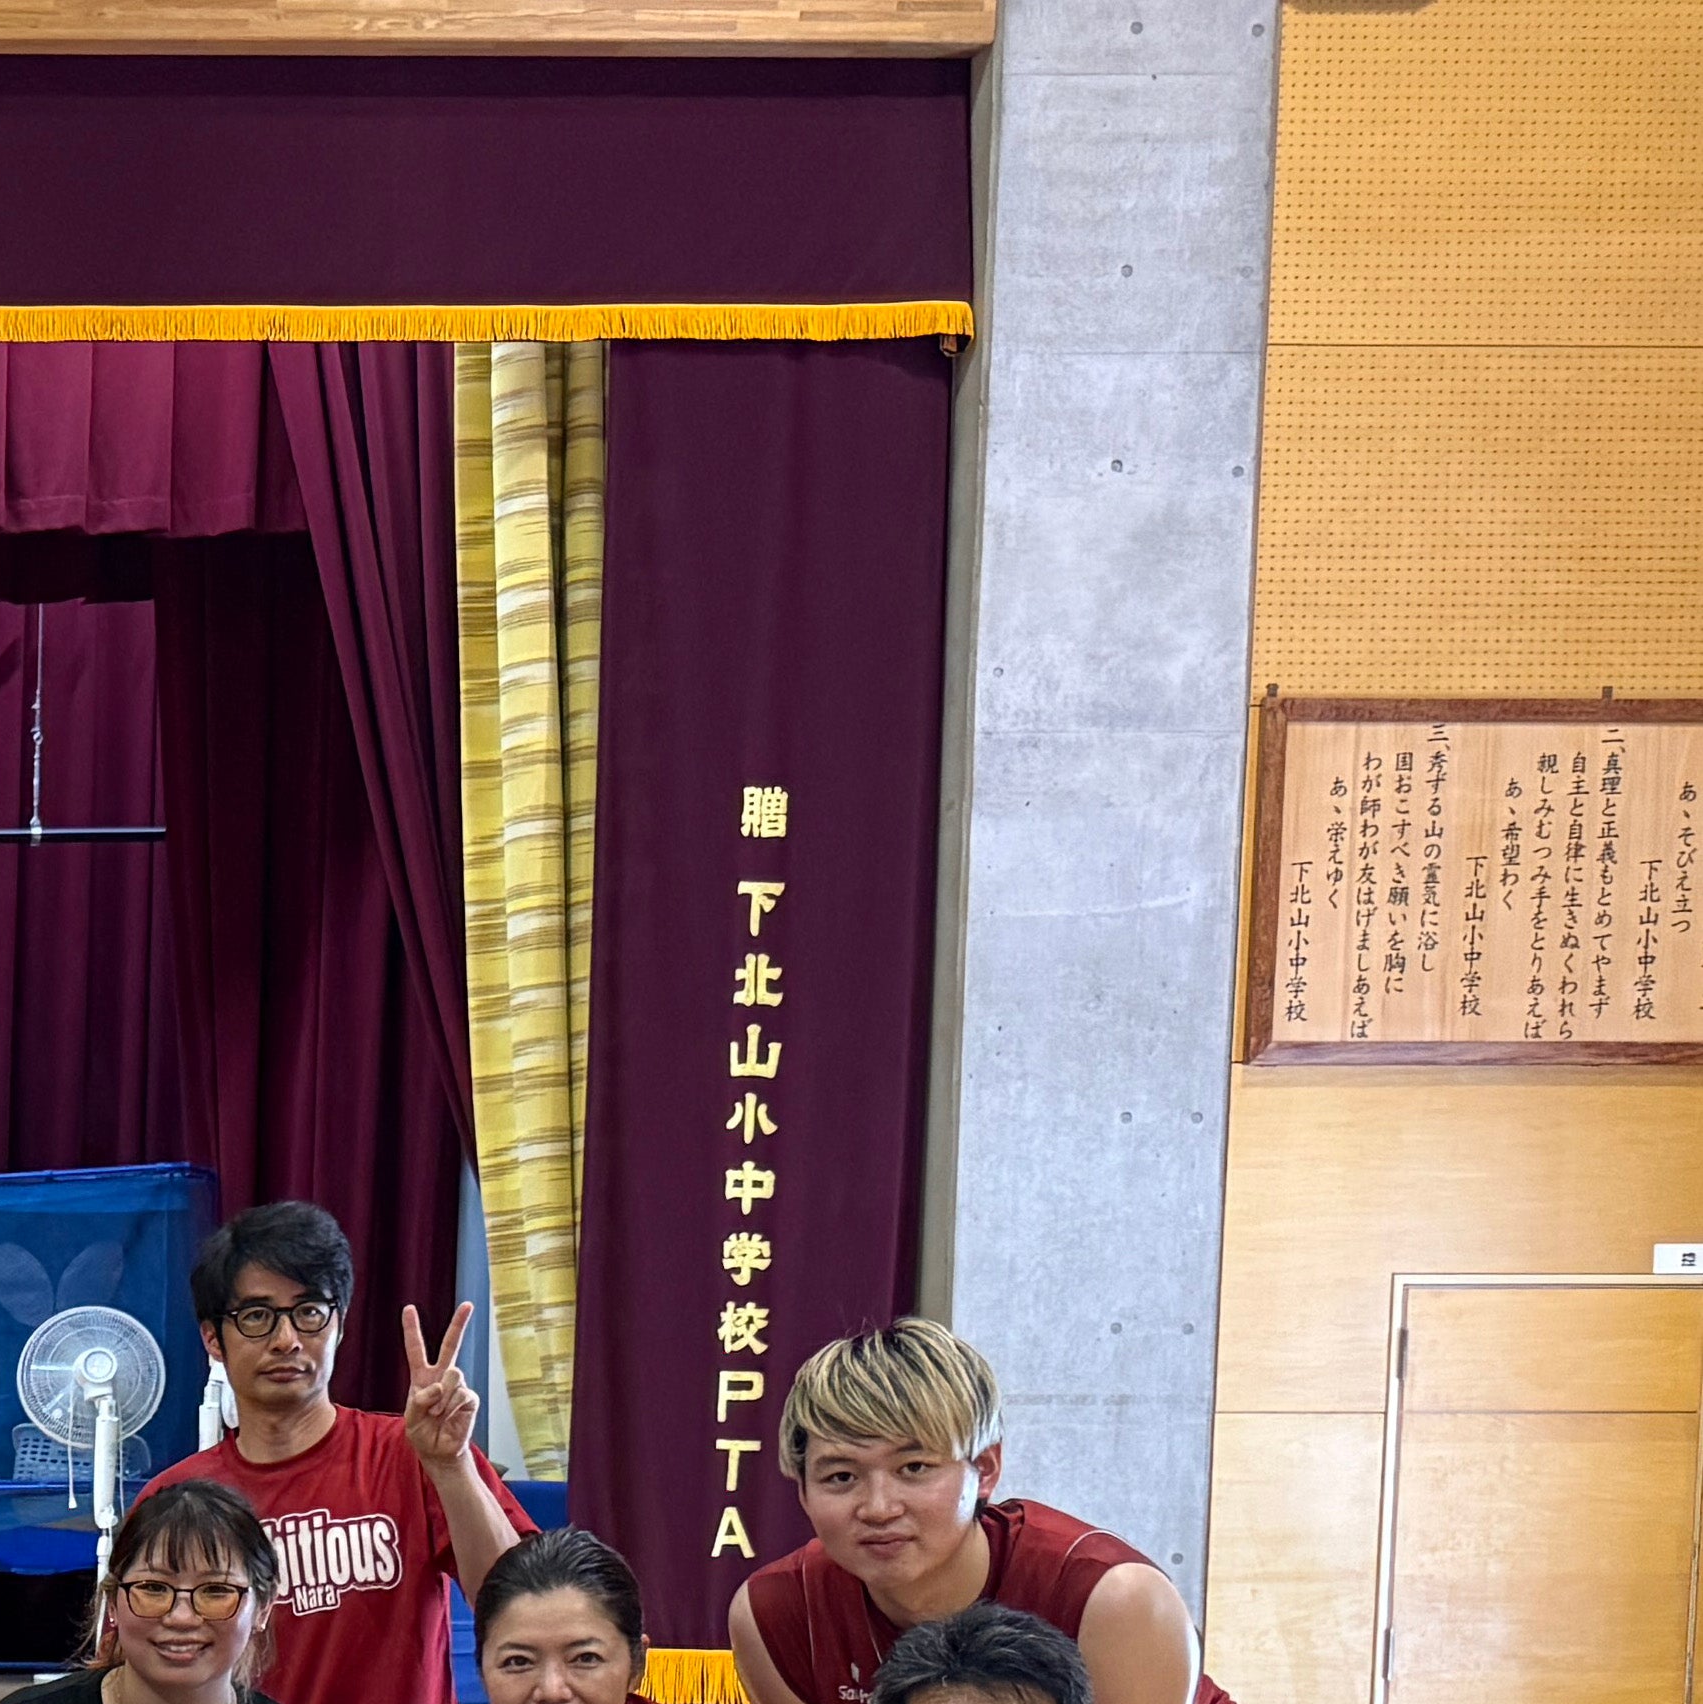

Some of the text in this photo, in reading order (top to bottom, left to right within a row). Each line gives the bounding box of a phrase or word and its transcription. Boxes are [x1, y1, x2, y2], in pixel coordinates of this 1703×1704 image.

[740, 785, 789, 840] 贈
[1285, 861, 1313, 1022] 下北山小中学校
[1459, 856, 1488, 1016] 下北山小中学校
[1634, 859, 1663, 1020] 下北山小中学校
[294, 1584, 337, 1612] Nara
